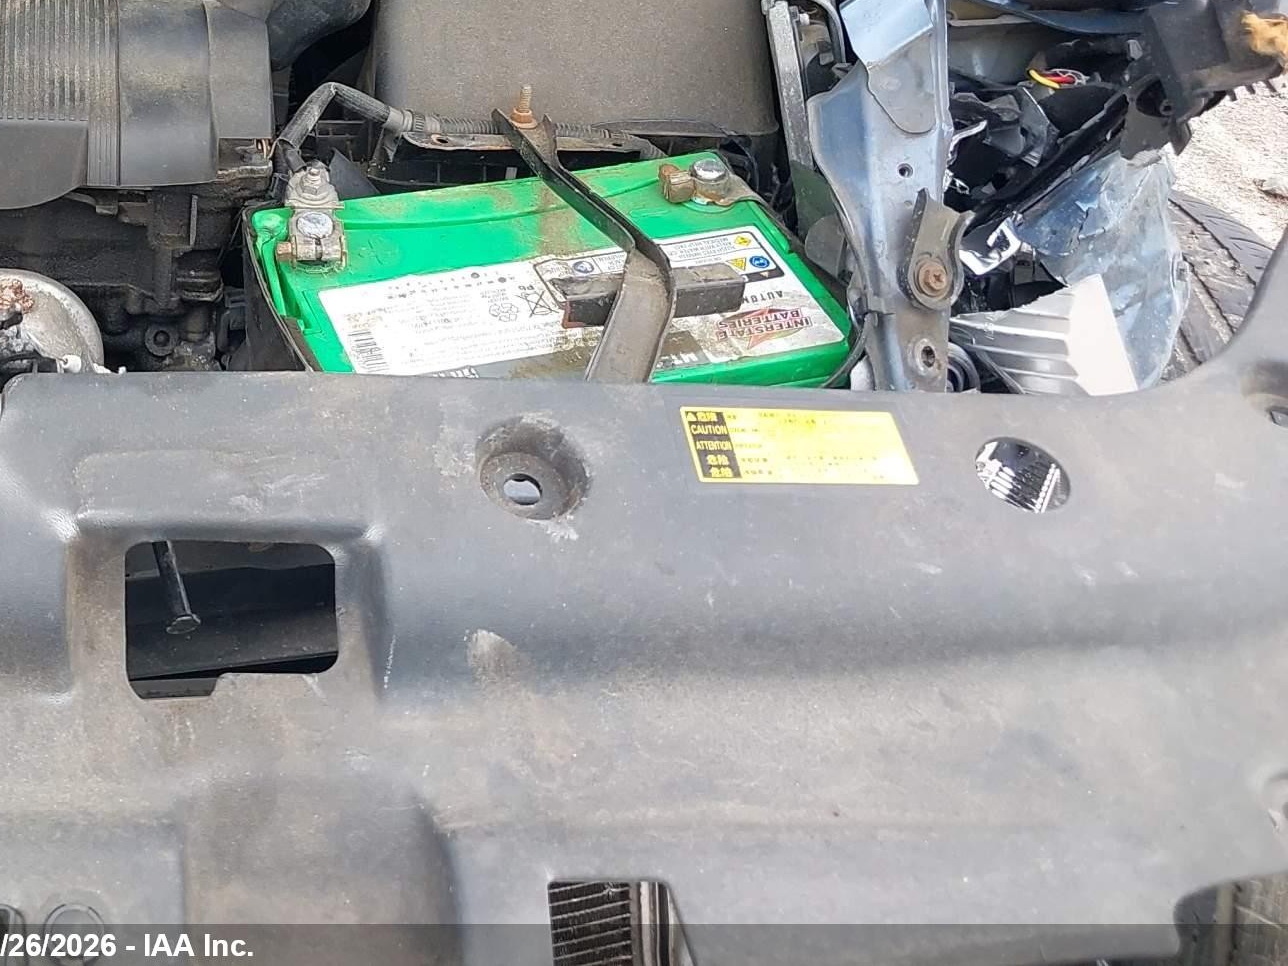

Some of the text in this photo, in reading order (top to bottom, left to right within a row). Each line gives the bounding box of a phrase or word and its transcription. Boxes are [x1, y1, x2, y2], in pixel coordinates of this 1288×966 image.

[718, 309, 801, 329] BATTERIES
[716, 316, 811, 340] INTERSTATE
[690, 424, 729, 435] CAUTION
[696, 440, 733, 451] ATTENTION
